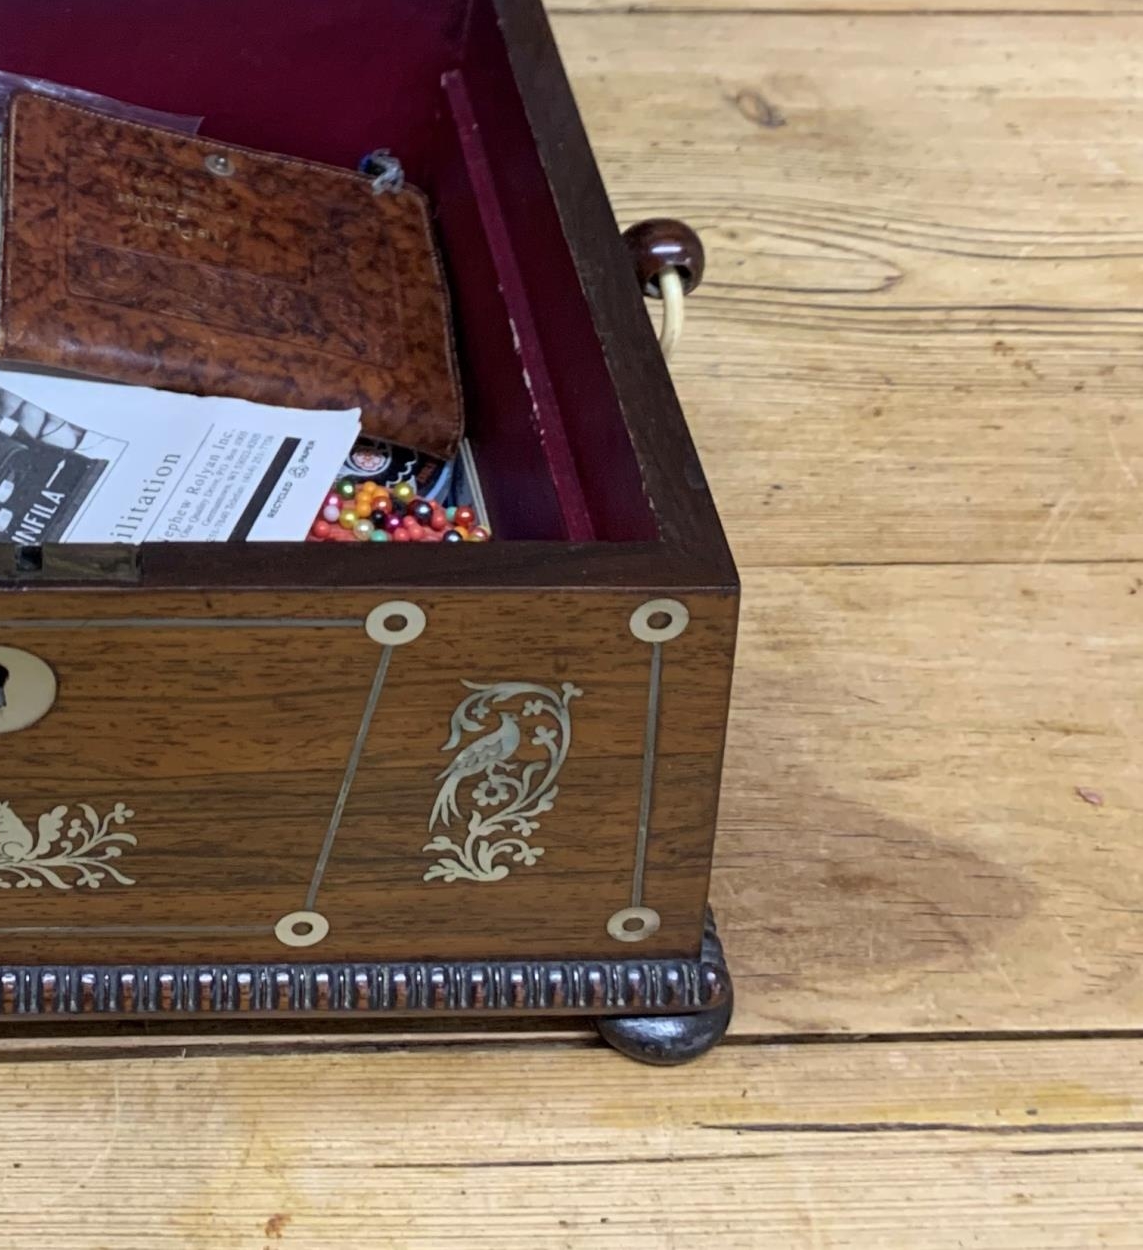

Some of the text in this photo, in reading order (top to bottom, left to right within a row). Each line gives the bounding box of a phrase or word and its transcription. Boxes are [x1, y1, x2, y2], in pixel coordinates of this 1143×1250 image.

[12, 490, 65, 545] INFILA
[110, 454, 181, 539] ilitation
[158, 500, 192, 542] ephew
[185, 454, 220, 496] Rolyan
[212, 429, 236, 450] Inc.
[267, 440, 316, 518] RECYCLED PAPER
